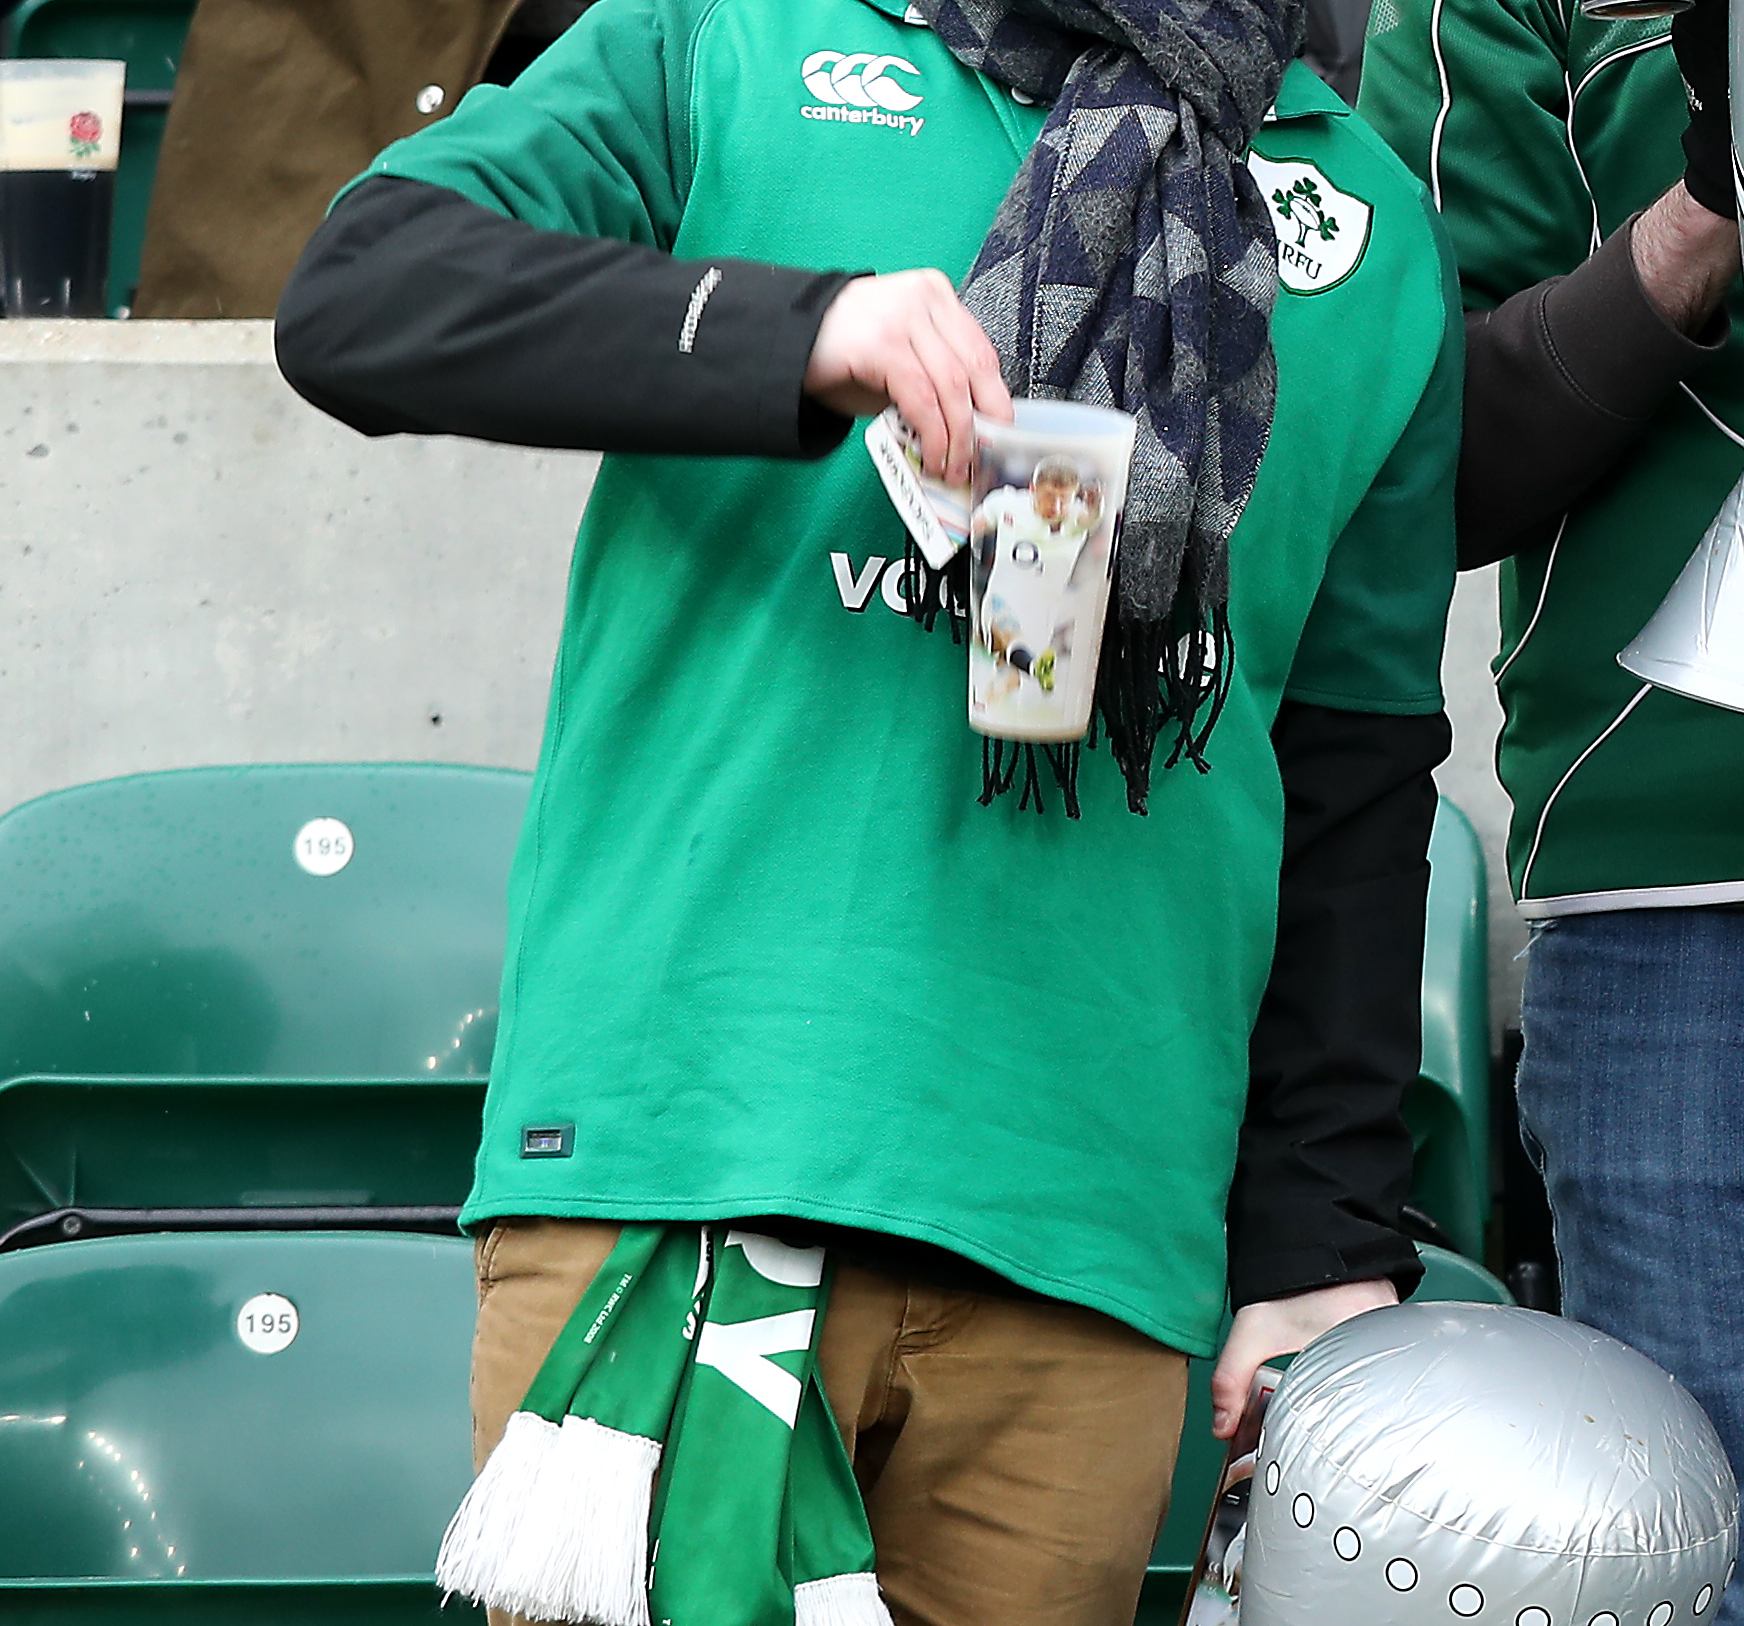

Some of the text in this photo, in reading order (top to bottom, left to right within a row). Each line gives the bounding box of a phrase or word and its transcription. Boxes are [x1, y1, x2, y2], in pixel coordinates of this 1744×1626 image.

[800, 105, 925, 137] canterbury
[304, 837, 346, 855] 195
[246, 1314, 291, 1333] 195
